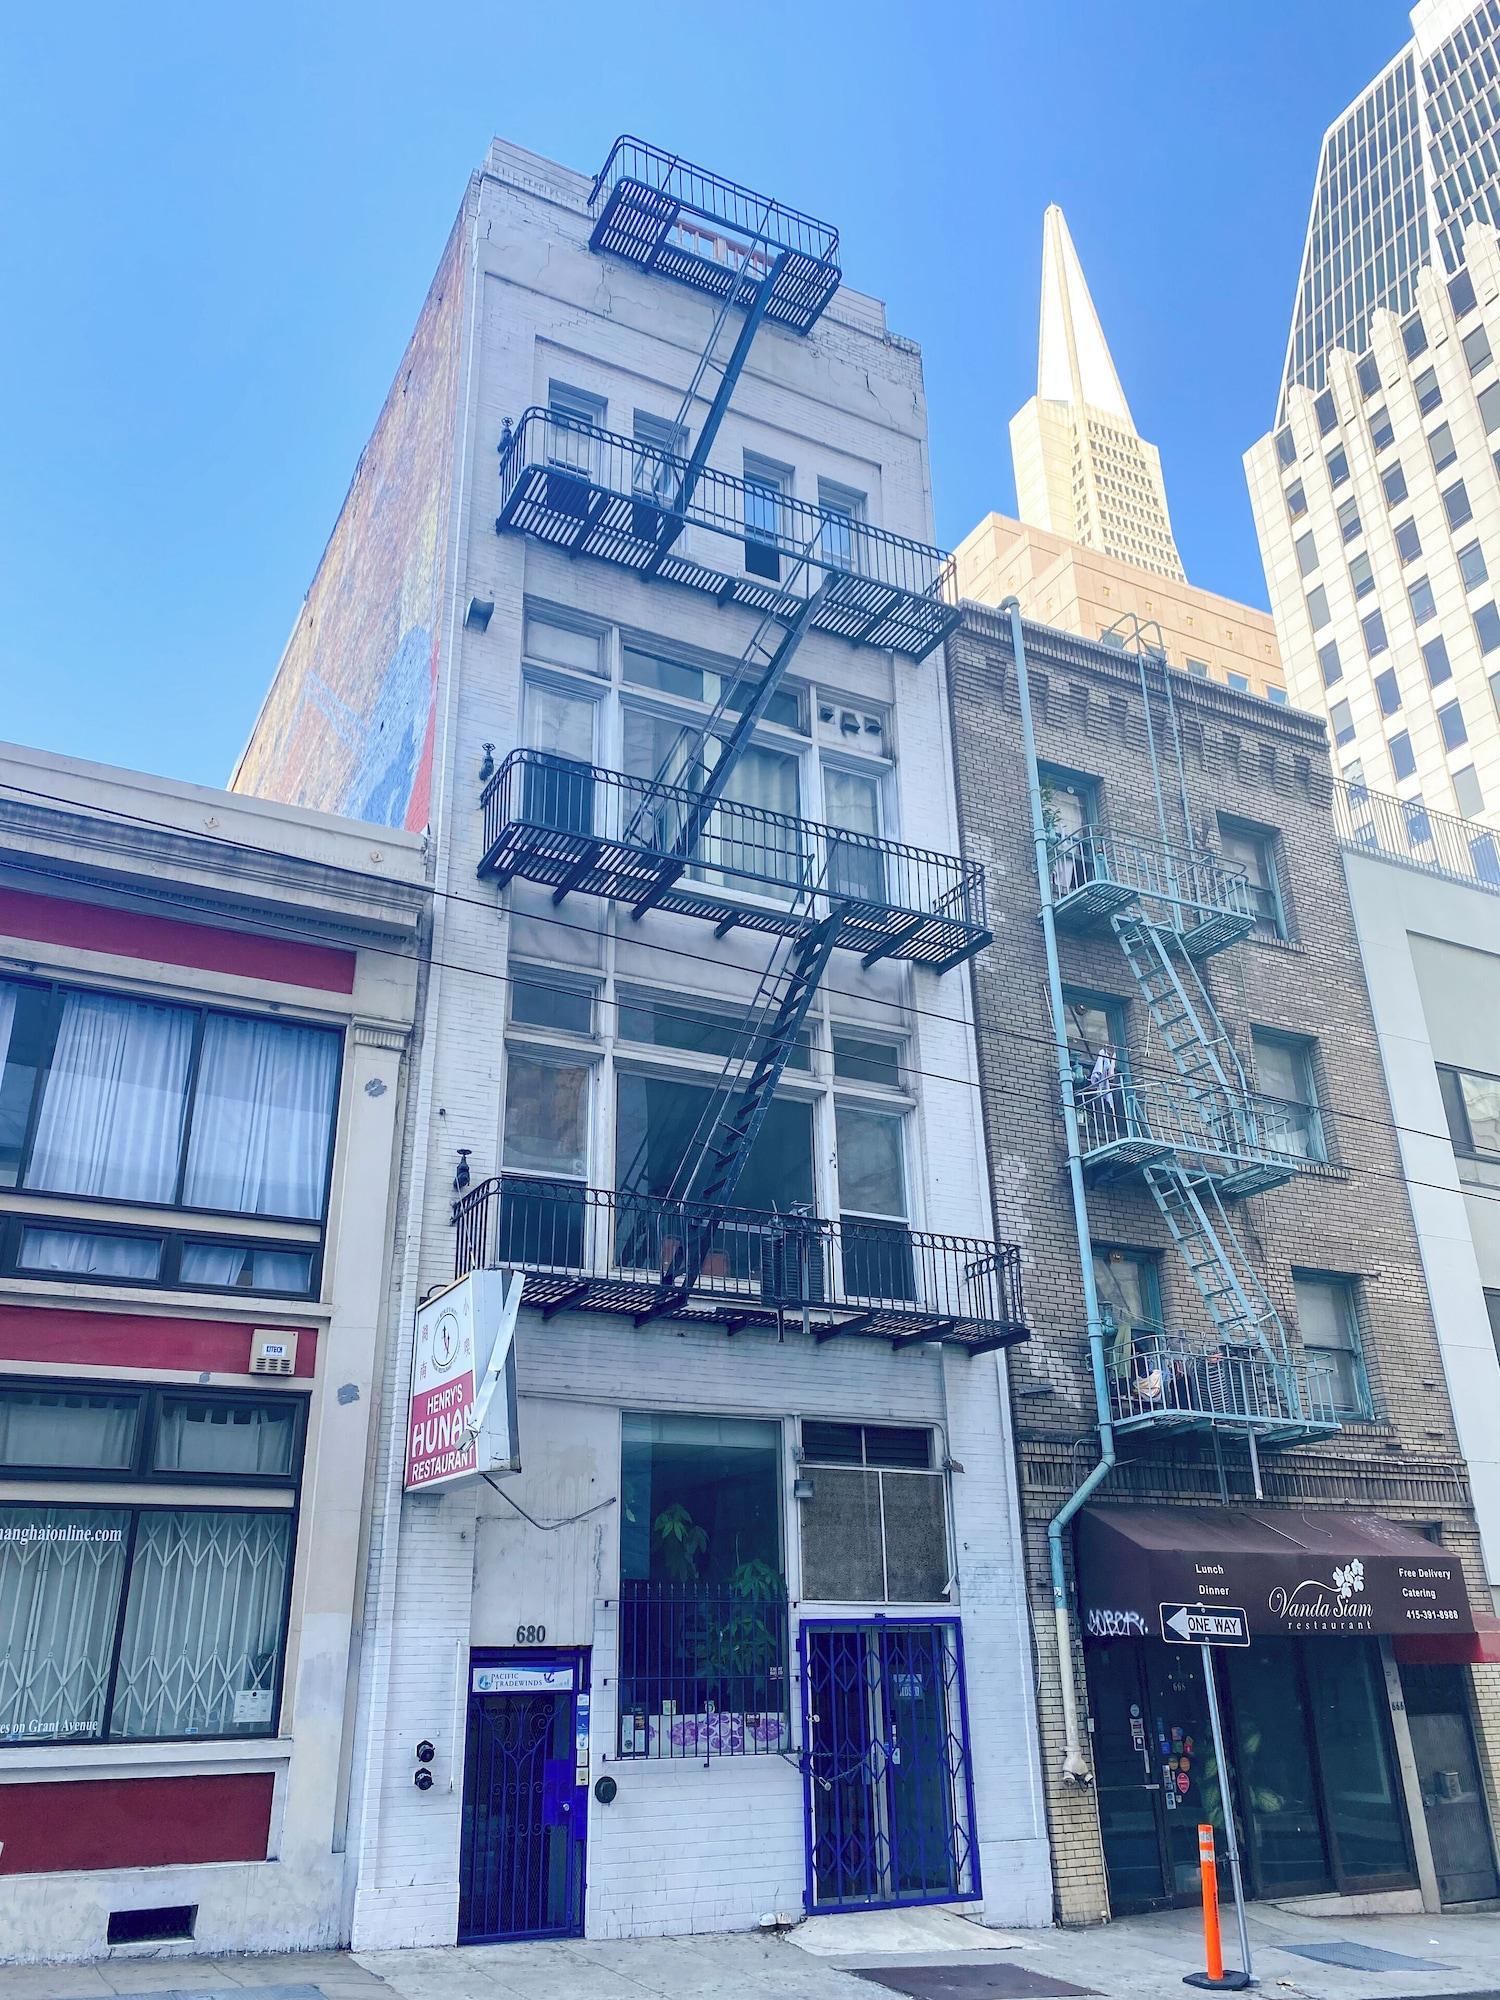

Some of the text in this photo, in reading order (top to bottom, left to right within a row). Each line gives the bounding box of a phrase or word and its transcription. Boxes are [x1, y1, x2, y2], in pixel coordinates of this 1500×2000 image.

[427, 1384, 463, 1416] HENRY'S
[412, 1448, 474, 1482] RESTAURANT
[1195, 1563, 1225, 1575] Lunch
[1399, 1568, 1451, 1580] Free Delivery
[1199, 1585, 1230, 1596] Dinner
[1402, 1588, 1437, 1600] Catering
[1268, 1582, 1374, 1619] Vanda Siam
[1187, 1616, 1238, 1634] ONE WAY
[1288, 1620, 1373, 1630] restaurant
[516, 1625, 546, 1643] 680
[491, 1673, 519, 1683] PACIFIC
[495, 1679, 543, 1690] TRADEWINDS
[0, 1718, 99, 1734] es on Grant Avenue
